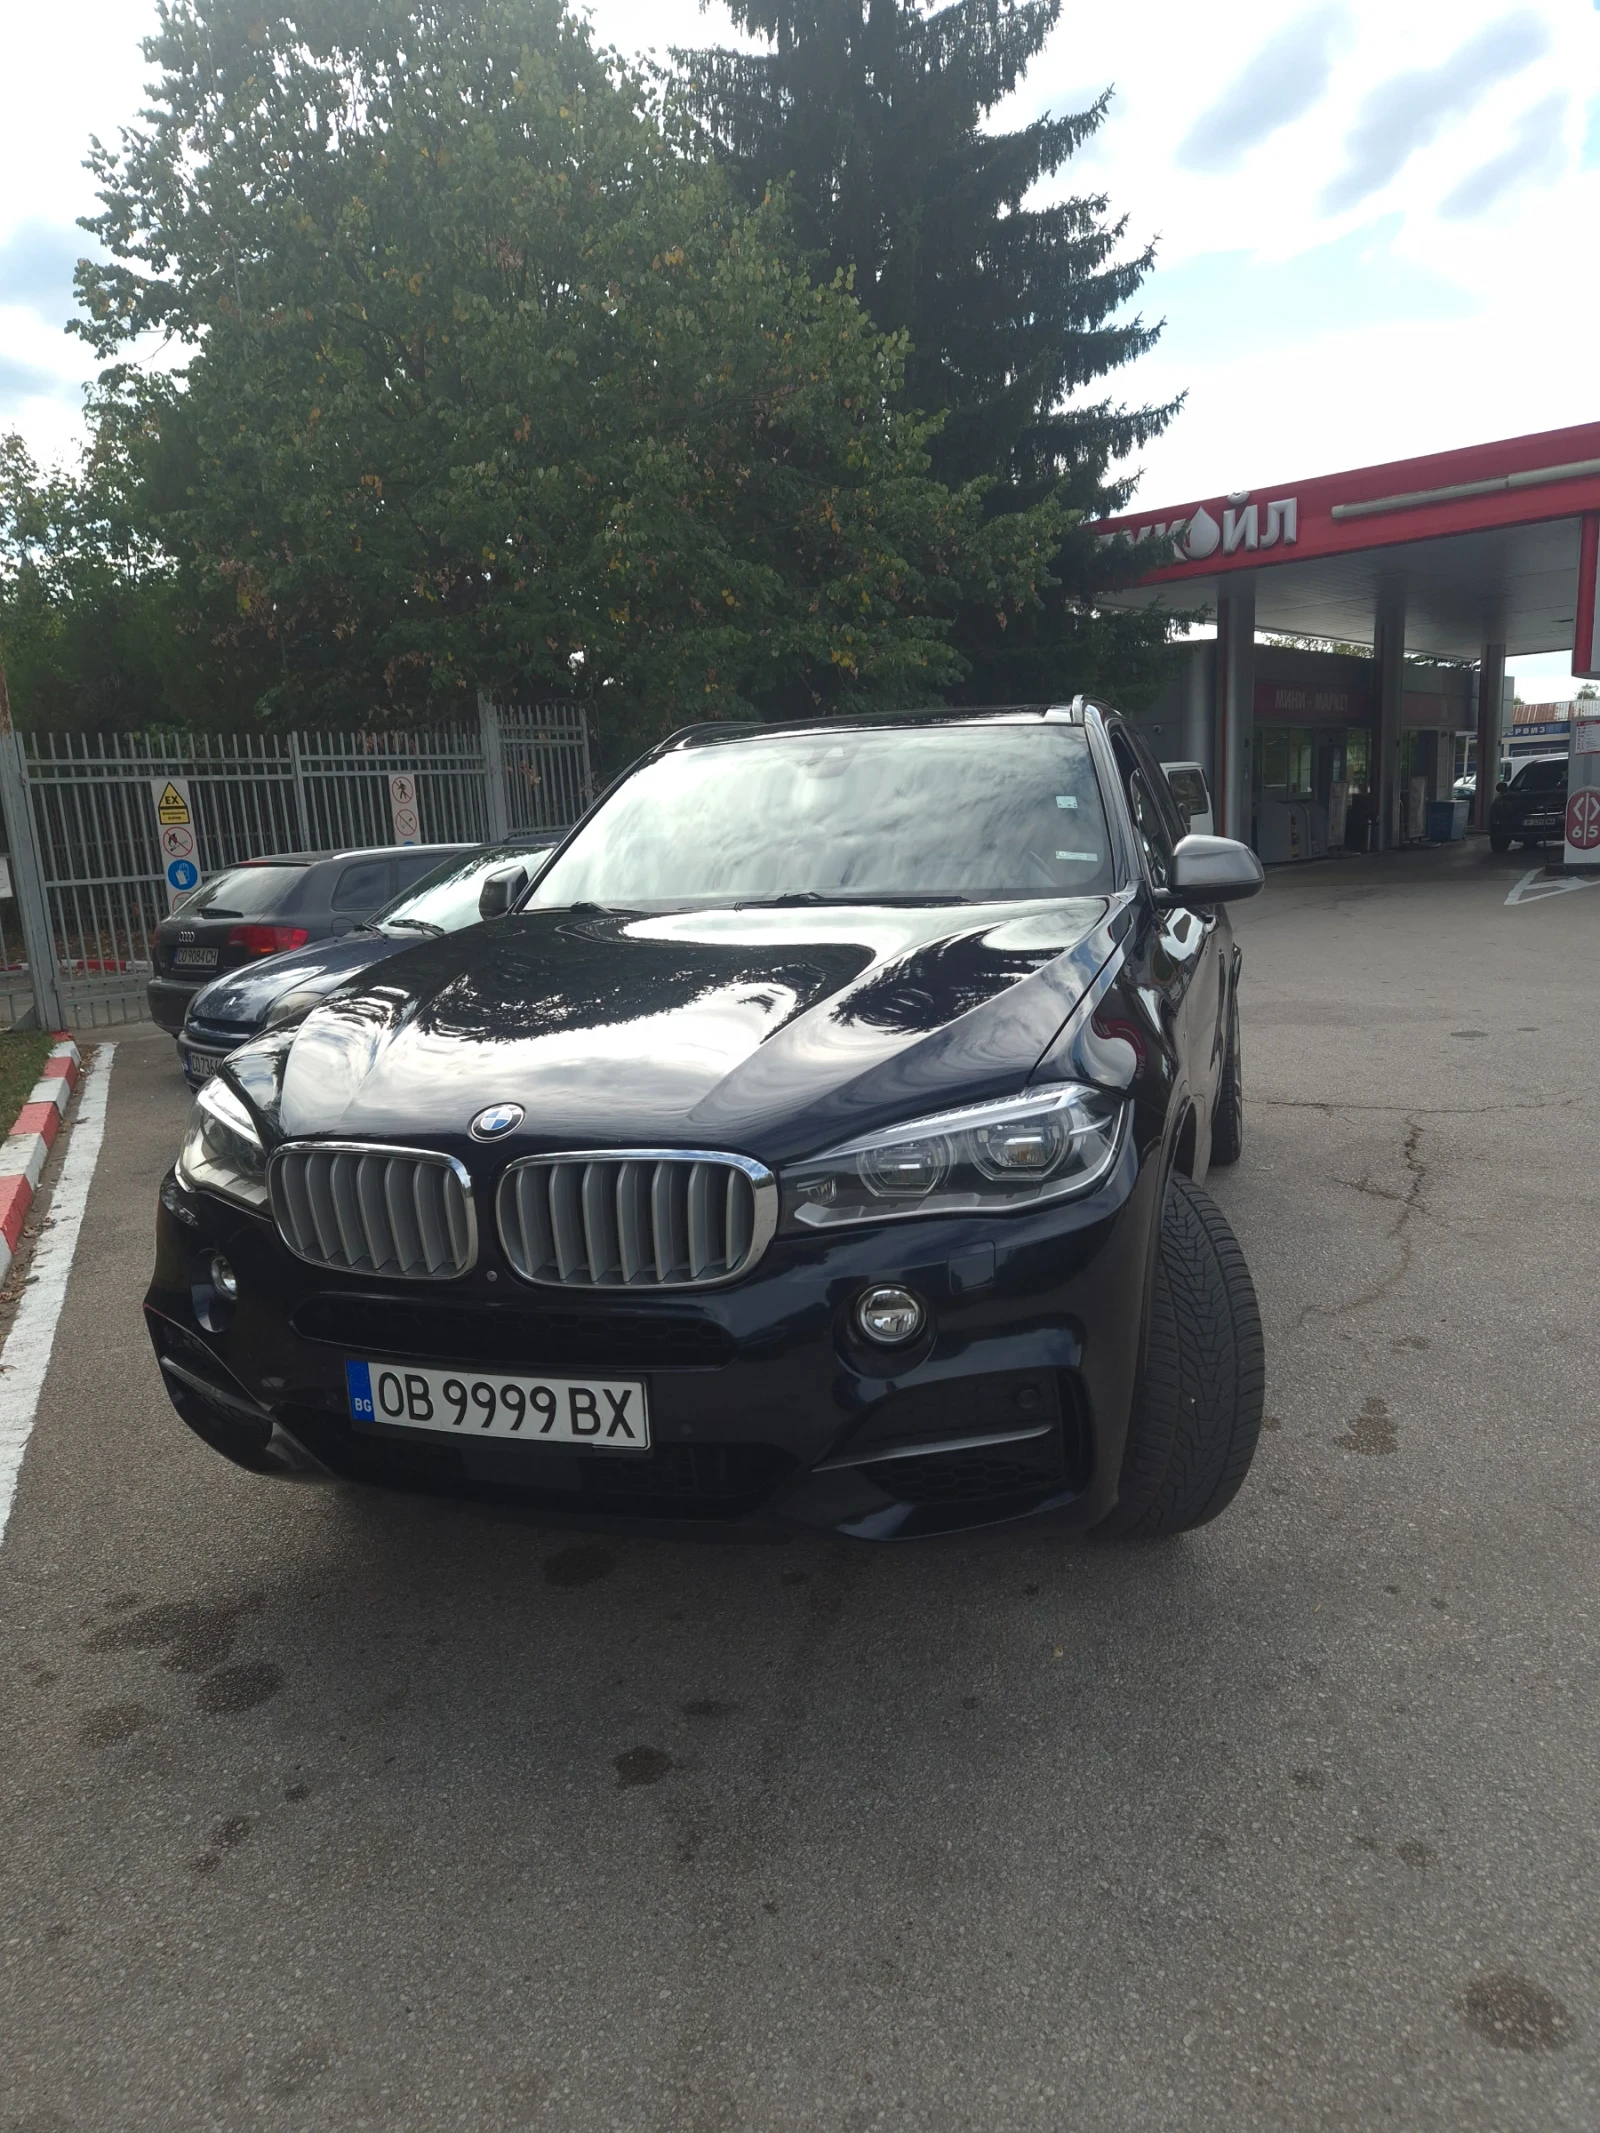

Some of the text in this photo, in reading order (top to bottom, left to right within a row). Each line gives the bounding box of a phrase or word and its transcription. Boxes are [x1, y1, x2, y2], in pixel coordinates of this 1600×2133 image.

[1275, 689, 1306, 709] МИНИ
[1314, 691, 1349, 712] МАРКЕТ
[165, 795, 180, 805] EX
[1572, 825, 1599, 838] 6 5
[205, 949, 216, 963] CH
[355, 1397, 372, 1413] BG
[378, 1371, 636, 1439] OB 9999 BX
